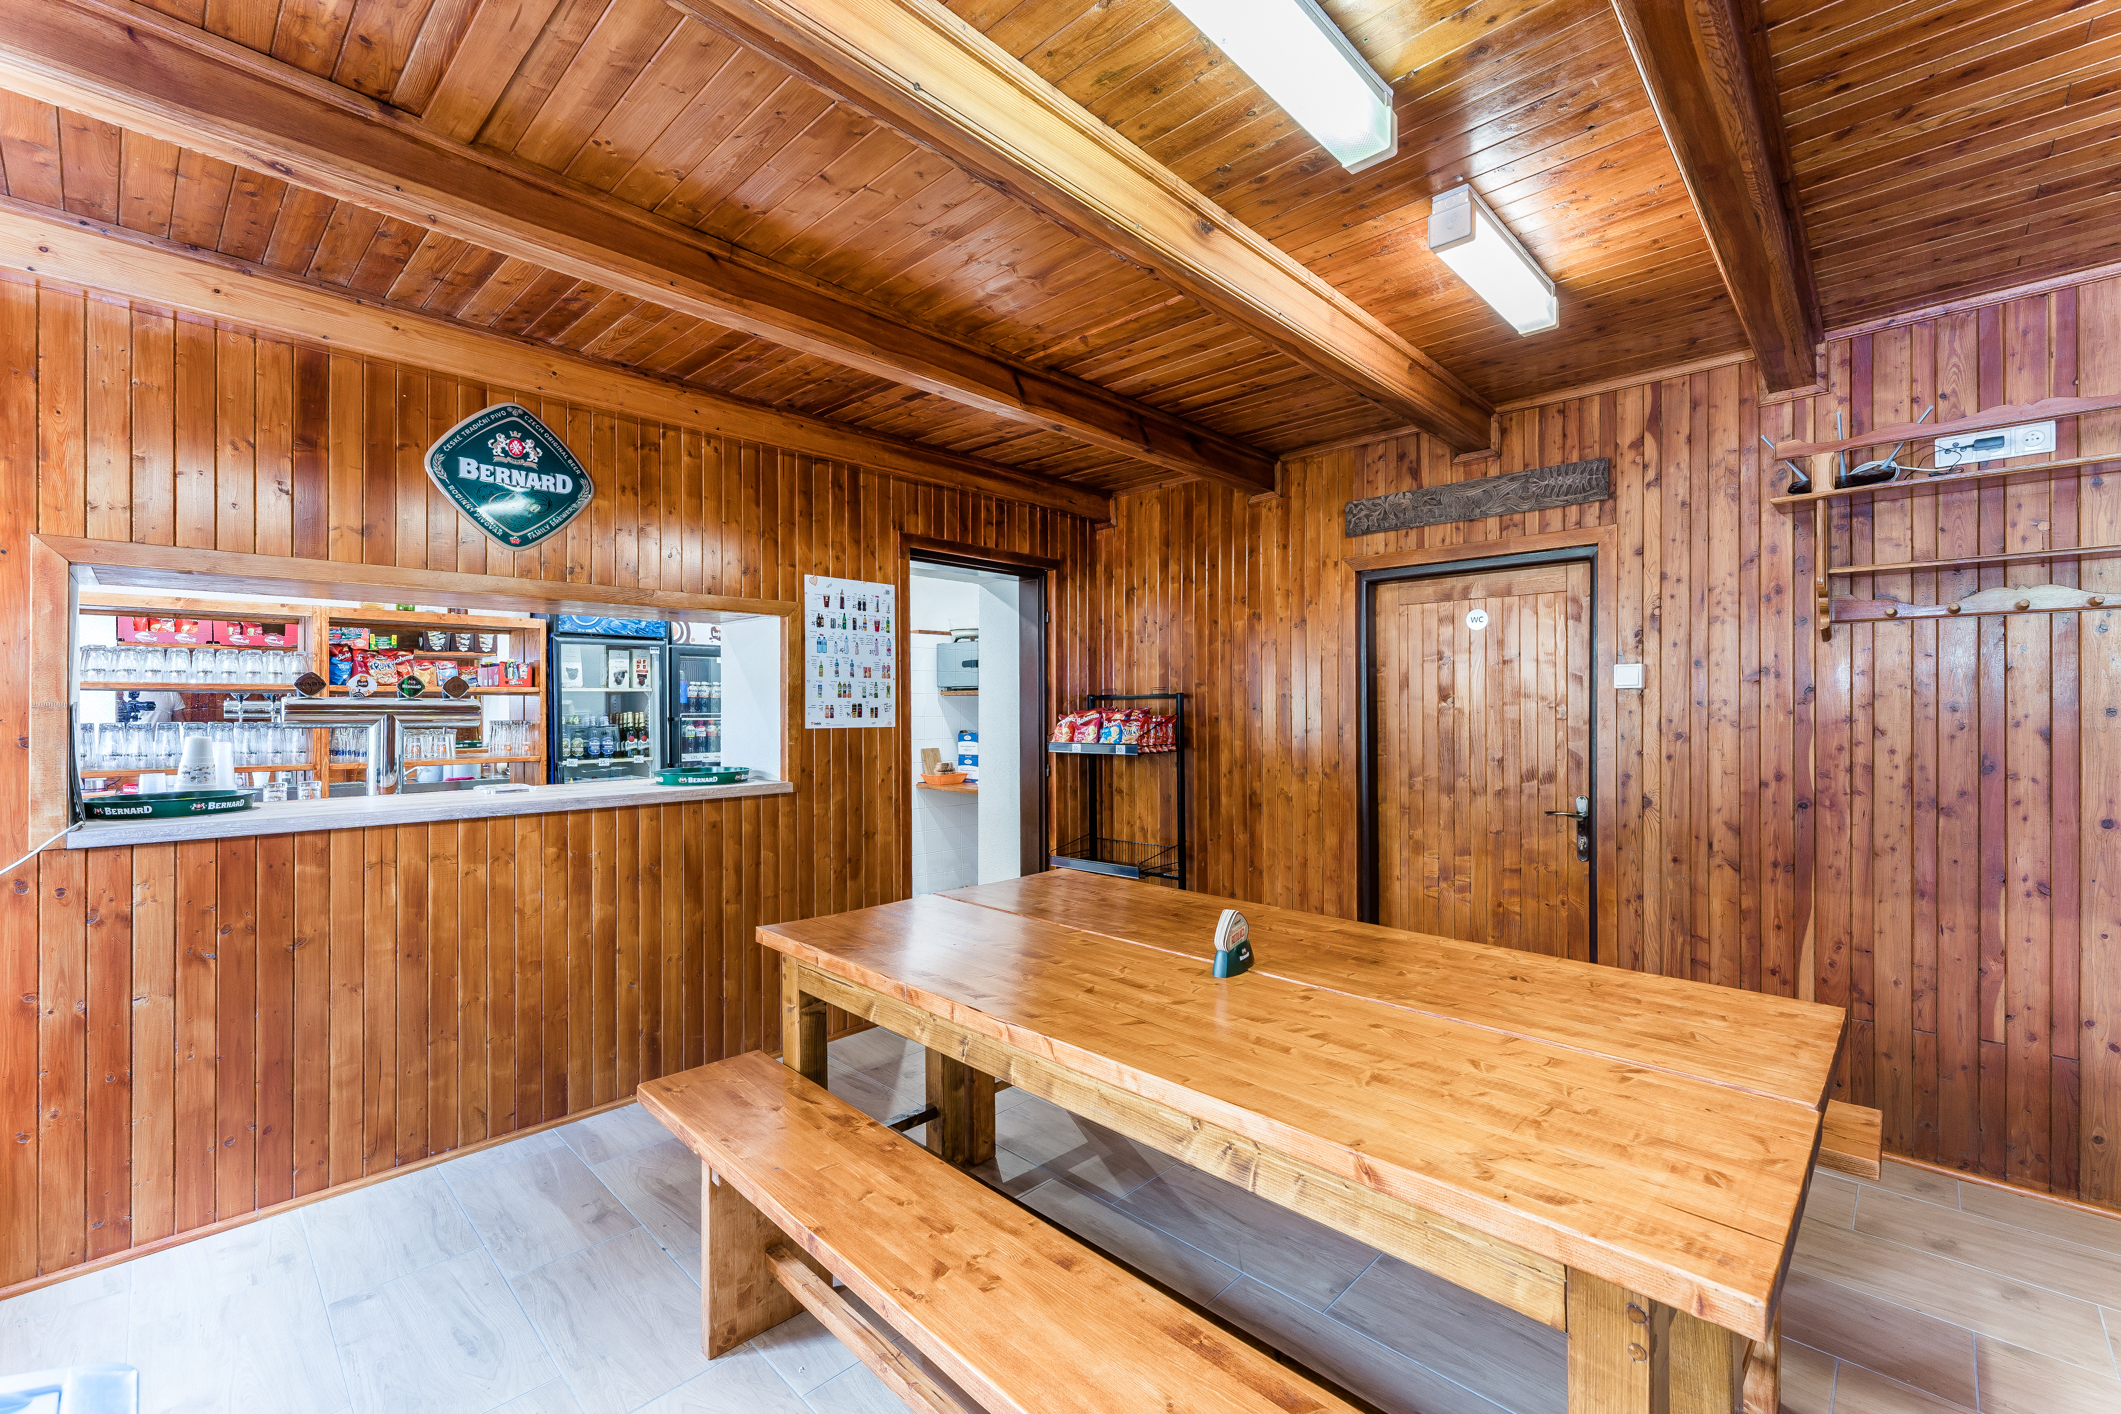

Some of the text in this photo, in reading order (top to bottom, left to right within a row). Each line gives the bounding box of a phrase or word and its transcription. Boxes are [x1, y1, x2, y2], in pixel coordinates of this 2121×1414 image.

[442, 410, 507, 452] ČESKÉ TRADIČNÍ PIVO
[524, 415, 582, 475] CZECH ORIGINAL BEER
[457, 456, 573, 495] BERNARD
[474, 511, 503, 537] PIVOVAR
[527, 503, 578, 540] FAMILY BREWERY
[687, 776, 718, 784] BERNARD
[104, 805, 153, 816] BERNARD
[207, 798, 245, 810] BERNARD
